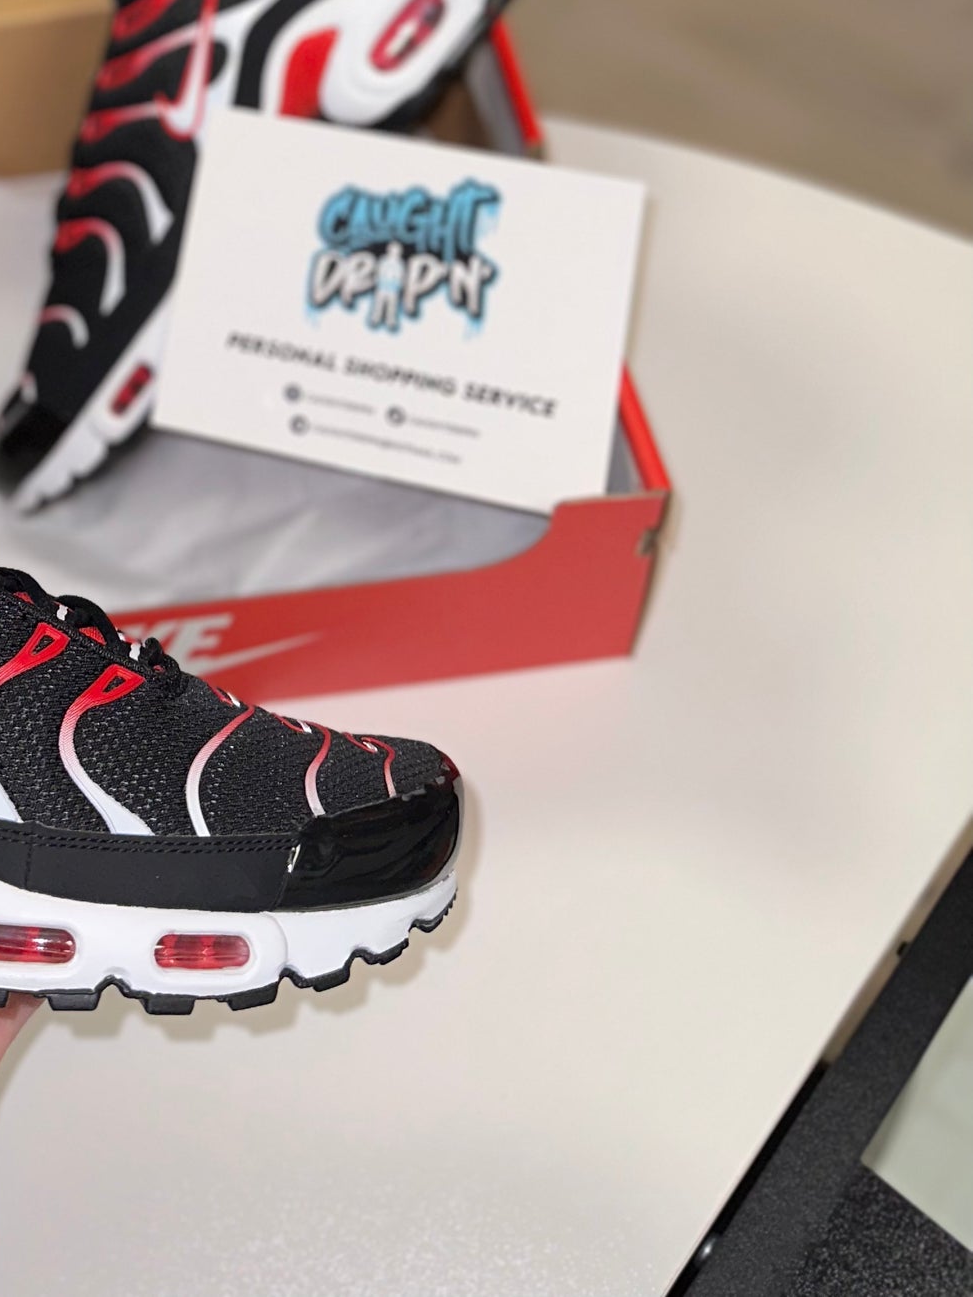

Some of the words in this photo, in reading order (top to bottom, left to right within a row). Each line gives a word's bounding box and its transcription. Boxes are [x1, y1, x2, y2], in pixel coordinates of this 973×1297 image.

[317, 177, 501, 264] CAUGHT
[225, 332, 336, 372] PERSONAL
[344, 356, 457, 397] SHOPPING
[464, 382, 557, 419] SERVICE
